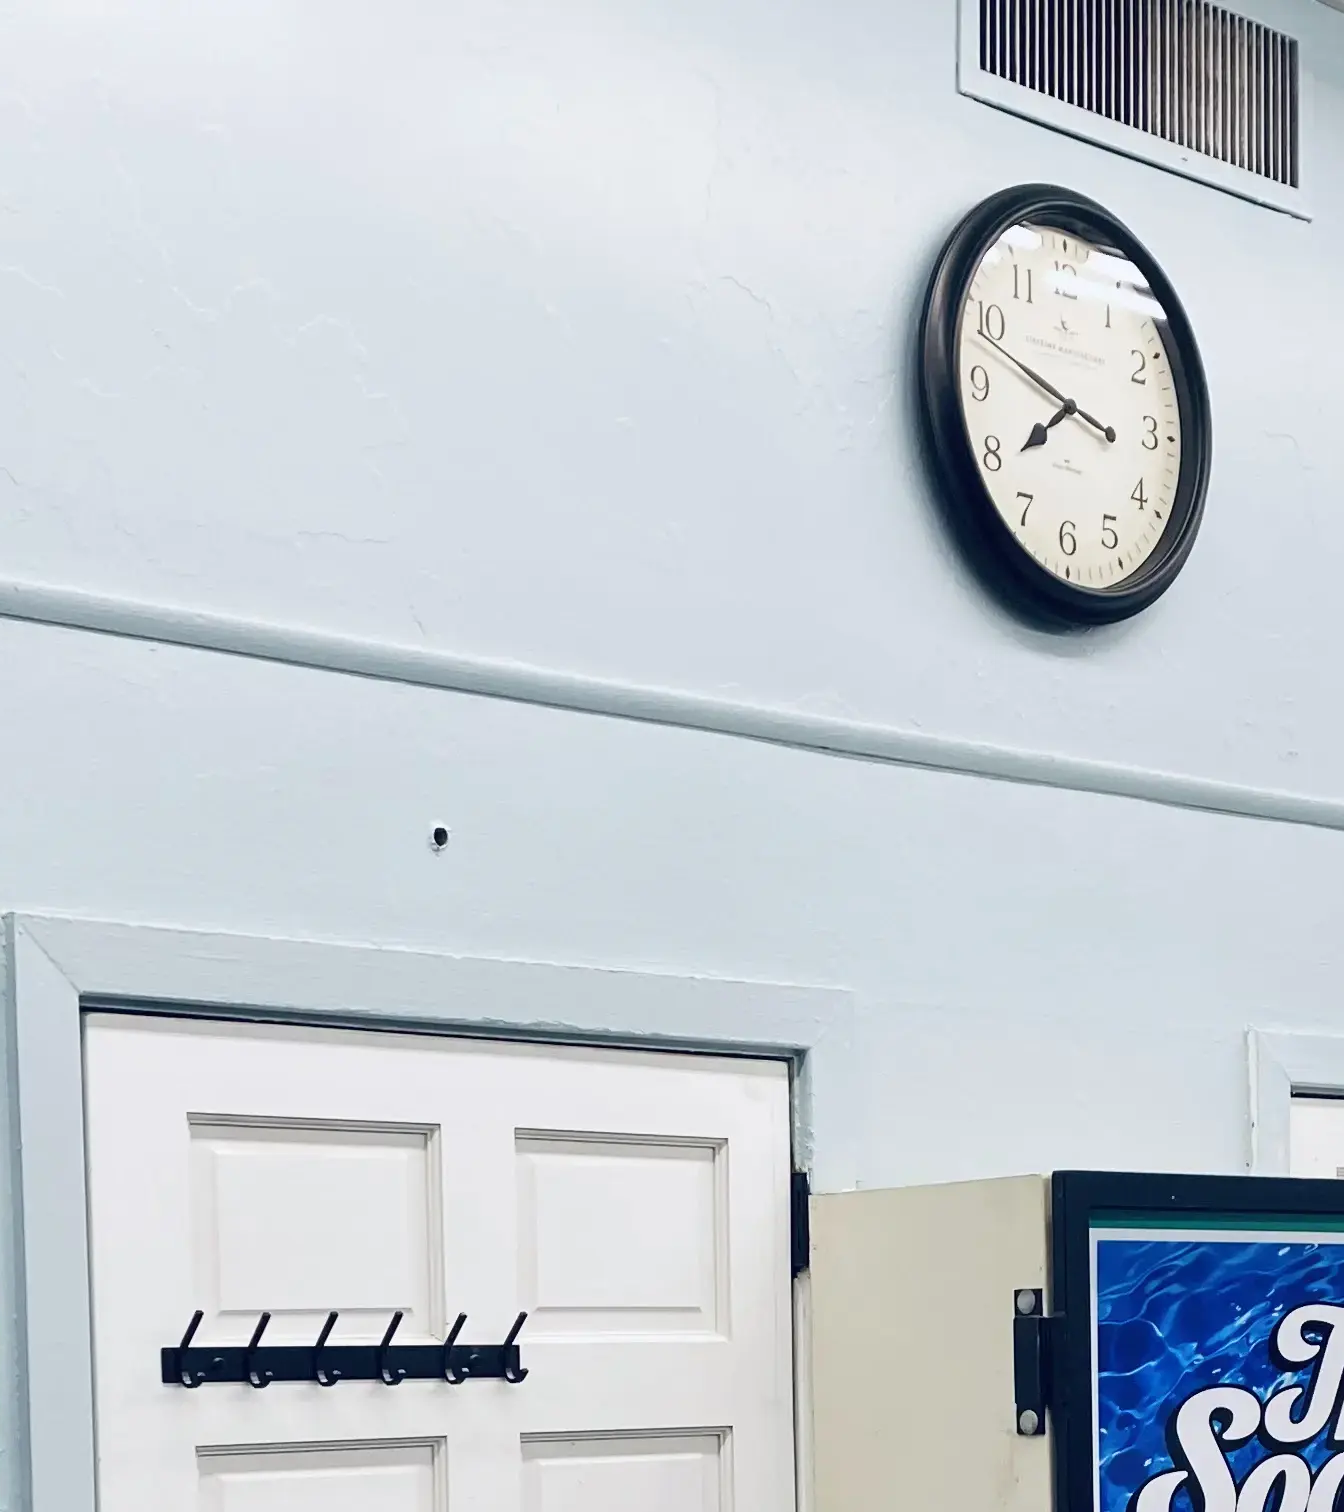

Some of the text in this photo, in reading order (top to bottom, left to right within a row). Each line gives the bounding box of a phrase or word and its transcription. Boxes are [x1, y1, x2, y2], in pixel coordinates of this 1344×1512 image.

[1013, 264, 1033, 303] 11
[979, 301, 1005, 340] 10
[970, 365, 990, 401] 9
[1131, 350, 1146, 385] 2
[1141, 416, 1159, 450] 3
[984, 435, 1002, 471] 8
[1017, 492, 1033, 526] 7
[1131, 478, 1148, 510] 4
[1059, 520, 1077, 556] 6
[1101, 514, 1119, 549] 5
